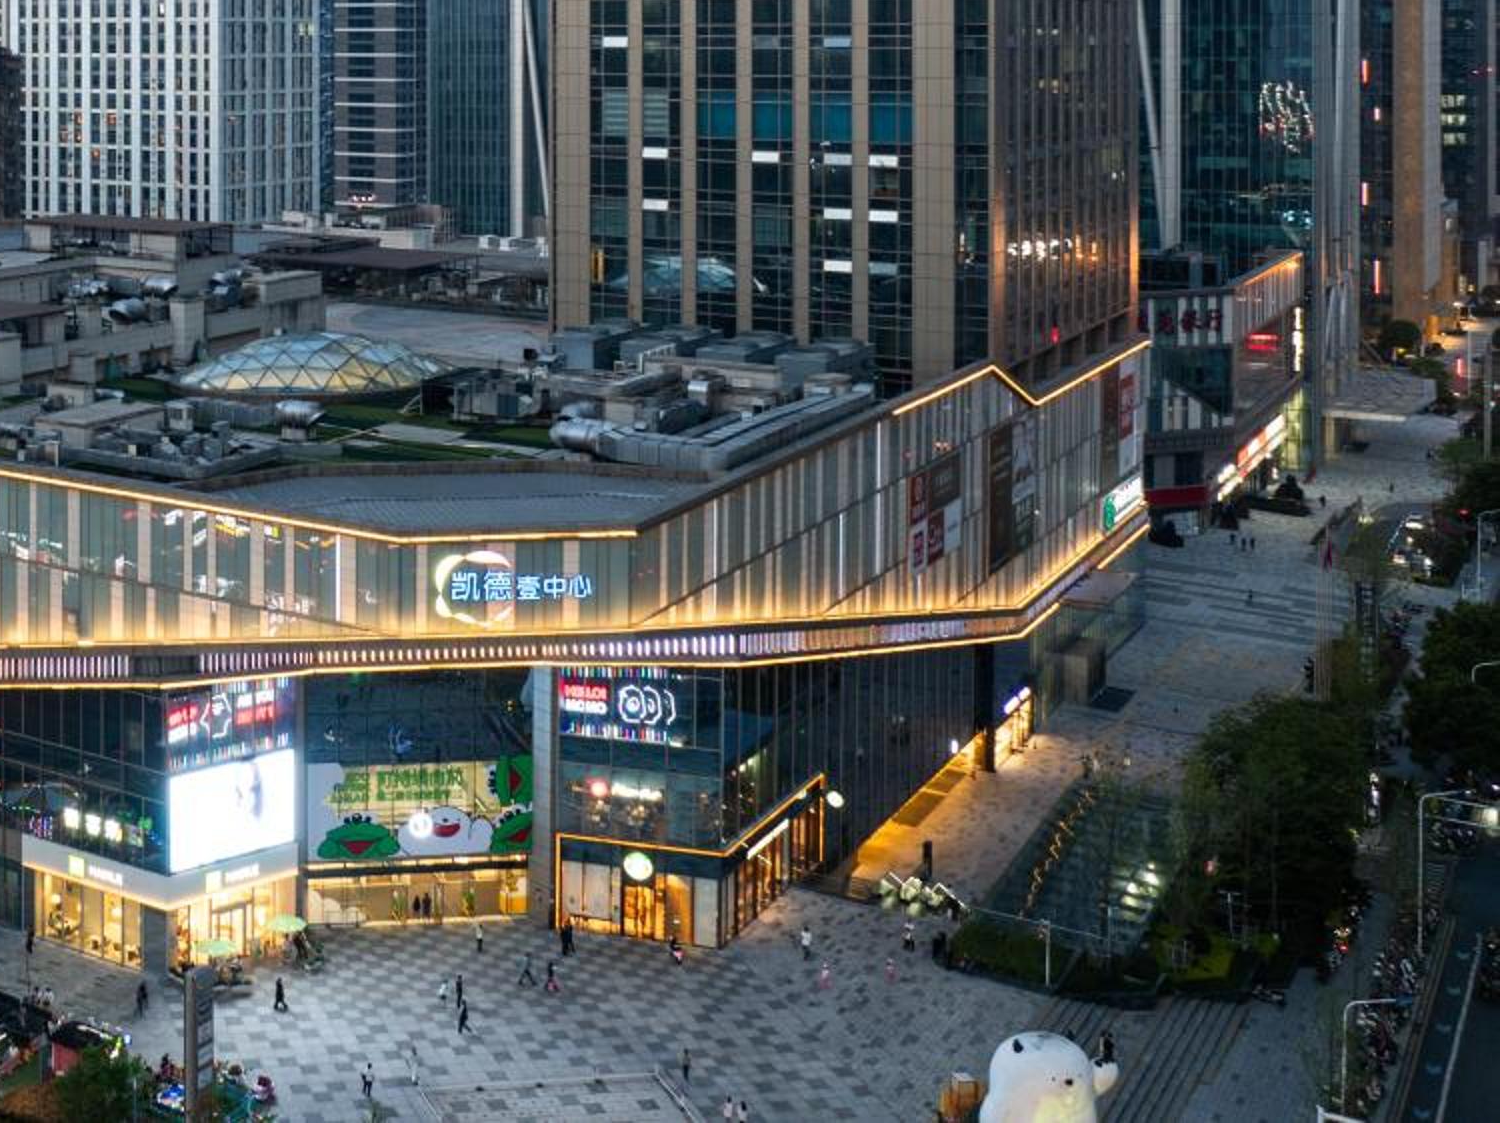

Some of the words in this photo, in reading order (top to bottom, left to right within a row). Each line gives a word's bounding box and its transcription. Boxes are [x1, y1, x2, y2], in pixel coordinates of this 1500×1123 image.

[451, 571, 592, 601] 凯德壹中心
